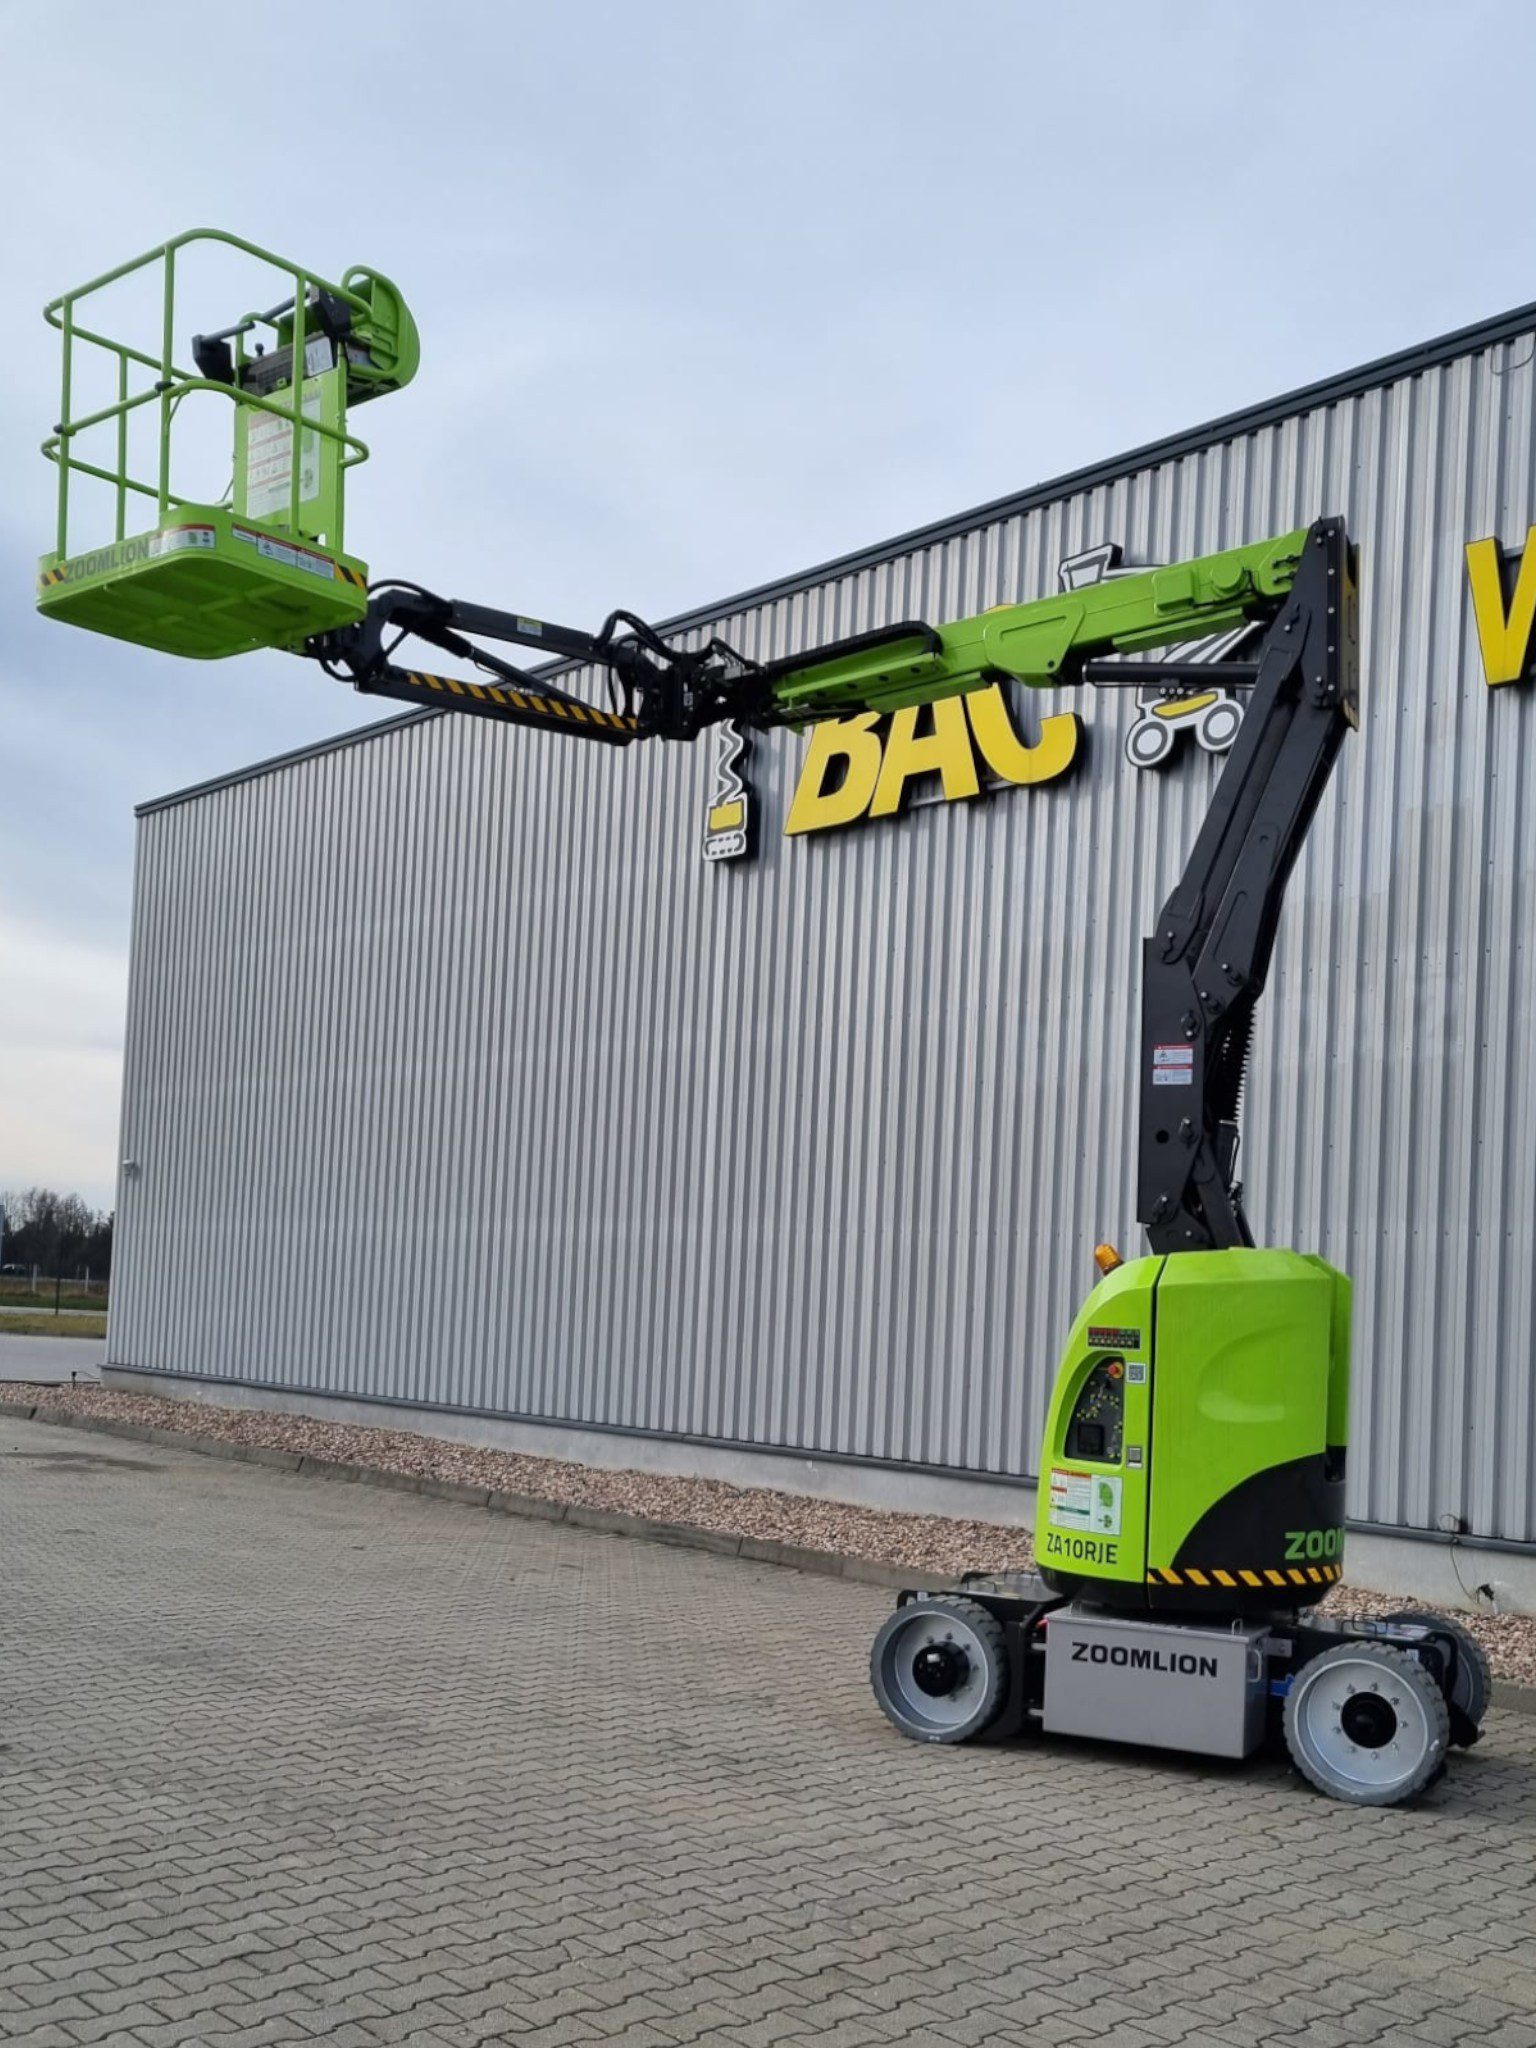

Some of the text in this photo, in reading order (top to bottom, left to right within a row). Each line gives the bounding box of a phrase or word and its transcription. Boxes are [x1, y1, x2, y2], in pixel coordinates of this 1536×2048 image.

[64, 538, 150, 584] ZOOMLION
[1047, 1532, 1118, 1565] ZA10RJE
[1071, 1641, 1218, 1677] ZOOMLION
